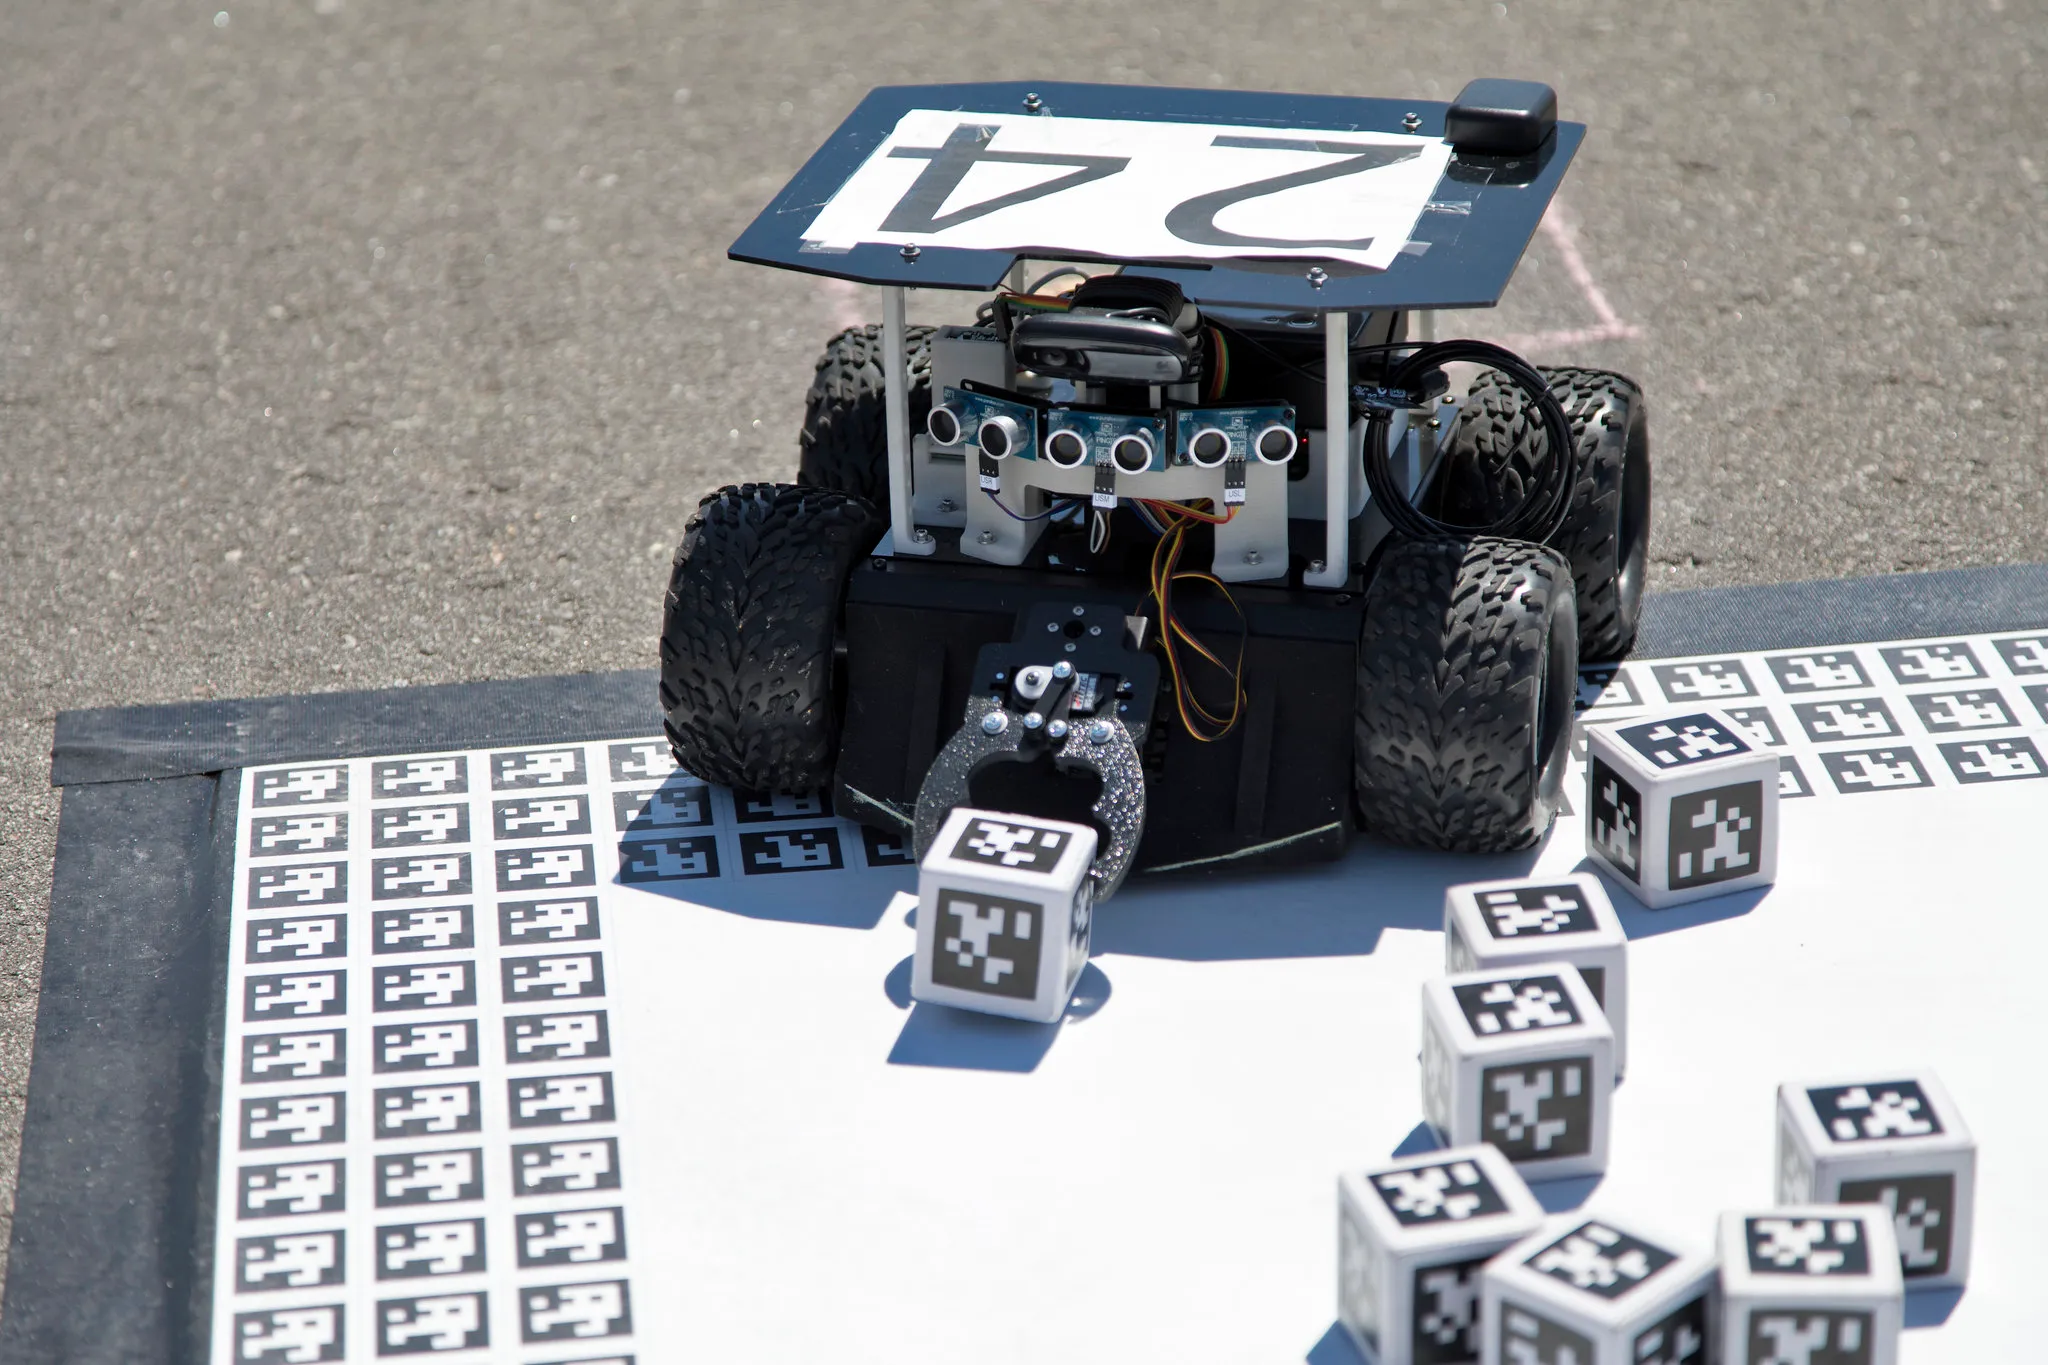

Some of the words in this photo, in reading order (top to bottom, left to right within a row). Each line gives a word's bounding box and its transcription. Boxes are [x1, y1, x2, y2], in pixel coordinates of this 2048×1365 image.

[878, 123, 1425, 251] 24
[1228, 489, 1242, 498] USL
[1094, 494, 1110, 503] USM
